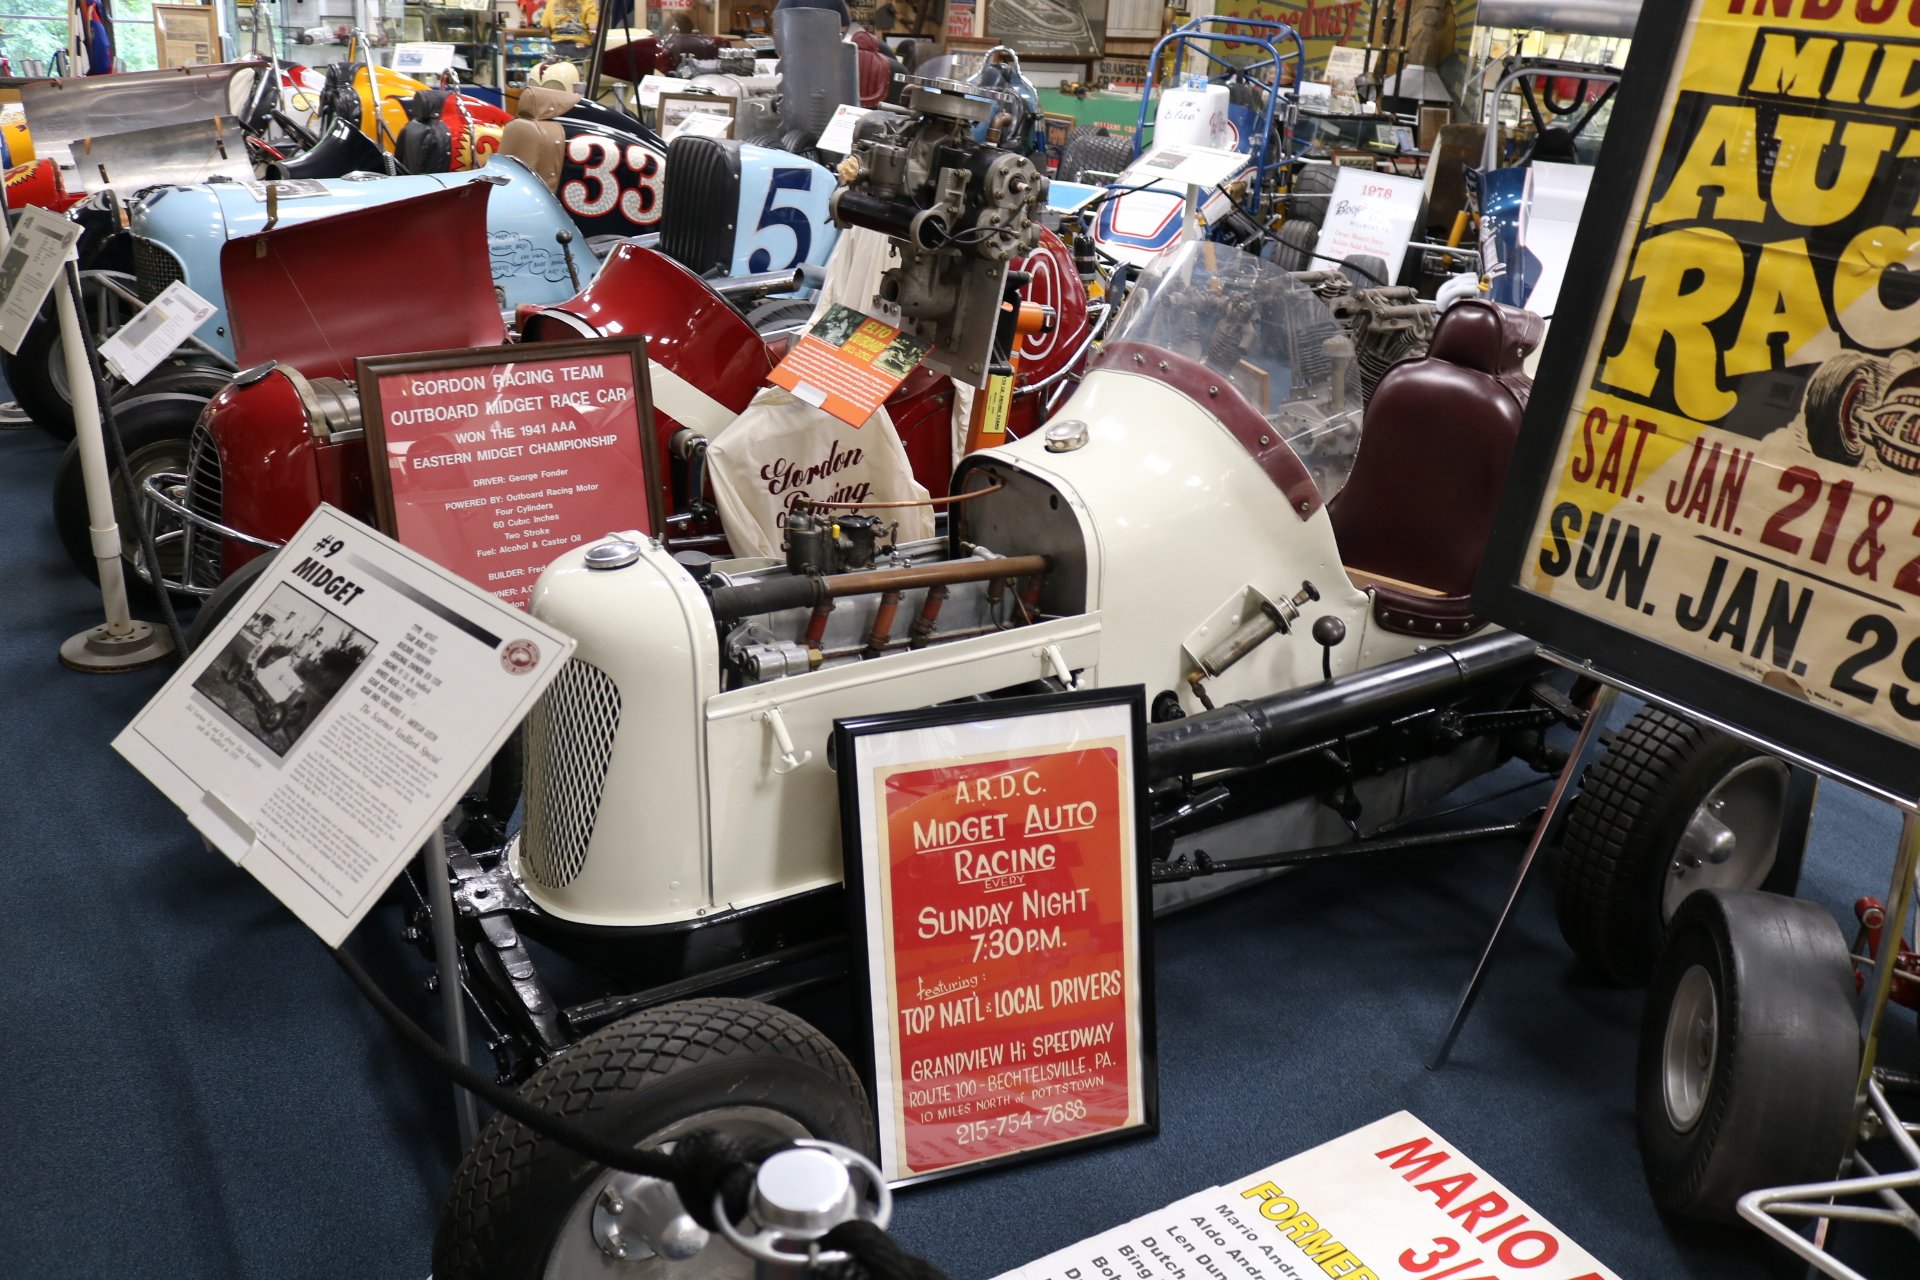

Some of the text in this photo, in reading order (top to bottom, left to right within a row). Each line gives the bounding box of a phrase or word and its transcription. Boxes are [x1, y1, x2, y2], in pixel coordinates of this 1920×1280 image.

[562, 134, 666, 225] 33
[1645, 104, 1920, 228] AU
[1360, 184, 1393, 200] 1978
[749, 168, 813, 274] 5
[411, 365, 604, 396] GORDON RACING TEAM
[391, 387, 627, 426] OUTBOARD MIDGET RACE CAR
[455, 420, 577, 444] WON THE 1941 AAA
[413, 434, 618, 470] EASTERN MIDGET CHAMPIONSHIP
[760, 439, 865, 496] Gordon
[473, 467, 569, 488] DRIVER: George Fonder
[1571, 407, 1657, 504] SAT.
[1665, 436, 1755, 536] JAN.
[445, 482, 599, 511] POWERED BY: Outboard Racing Motor
[495, 502, 554, 517] Four Cylinders
[493, 512, 560, 529] 60 Cubic Inches
[504, 527, 550, 541] Two Stroke
[314, 535, 344, 559] #9
[476, 534, 582, 558] Fuel: Alcohol & Castor Oil
[292, 557, 365, 606] MIDGET
[488, 564, 546, 581] BUILDER: Fred
[1538, 502, 1661, 616] SUN.
[1675, 556, 1814, 677] JAN.
[491, 587, 518, 598] WNER:
[956, 770, 1047, 805] A.R.D.C.
[913, 800, 1098, 850] MIDGET AUTO
[954, 844, 1056, 882] RACING
[984, 874, 1025, 890] EVERY
[917, 888, 1090, 939] SUNDAY NIGHT
[901, 1006, 935, 1037] TOP
[940, 989, 985, 1030] NAT'L
[994, 984, 1044, 1019] LOCAL
[1050, 969, 1122, 1008] DRIVERS
[910, 1022, 1114, 1083] GRANDVIEW Hi SPEEDWAY
[909, 1085, 952, 1108] ROUTE
[955, 1080, 977, 1099] 100
[987, 1057, 1092, 1094] BECHTELSVILLE,
[1095, 1050, 1117, 1070] PA.
[920, 1075, 1105, 1124] 10 MILES NORTH of POTTSTOWN
[956, 1098, 1087, 1147] 215-754-7688
[1374, 1136, 1559, 1269] MARIO
[1166, 1225, 1196, 1252] Len
[1190, 1216, 1226, 1246] Aldo
[1215, 1204, 1258, 1241] Mario
[1118, 1244, 1153, 1279] Bing
[1141, 1236, 1186, 1280] Dutch
